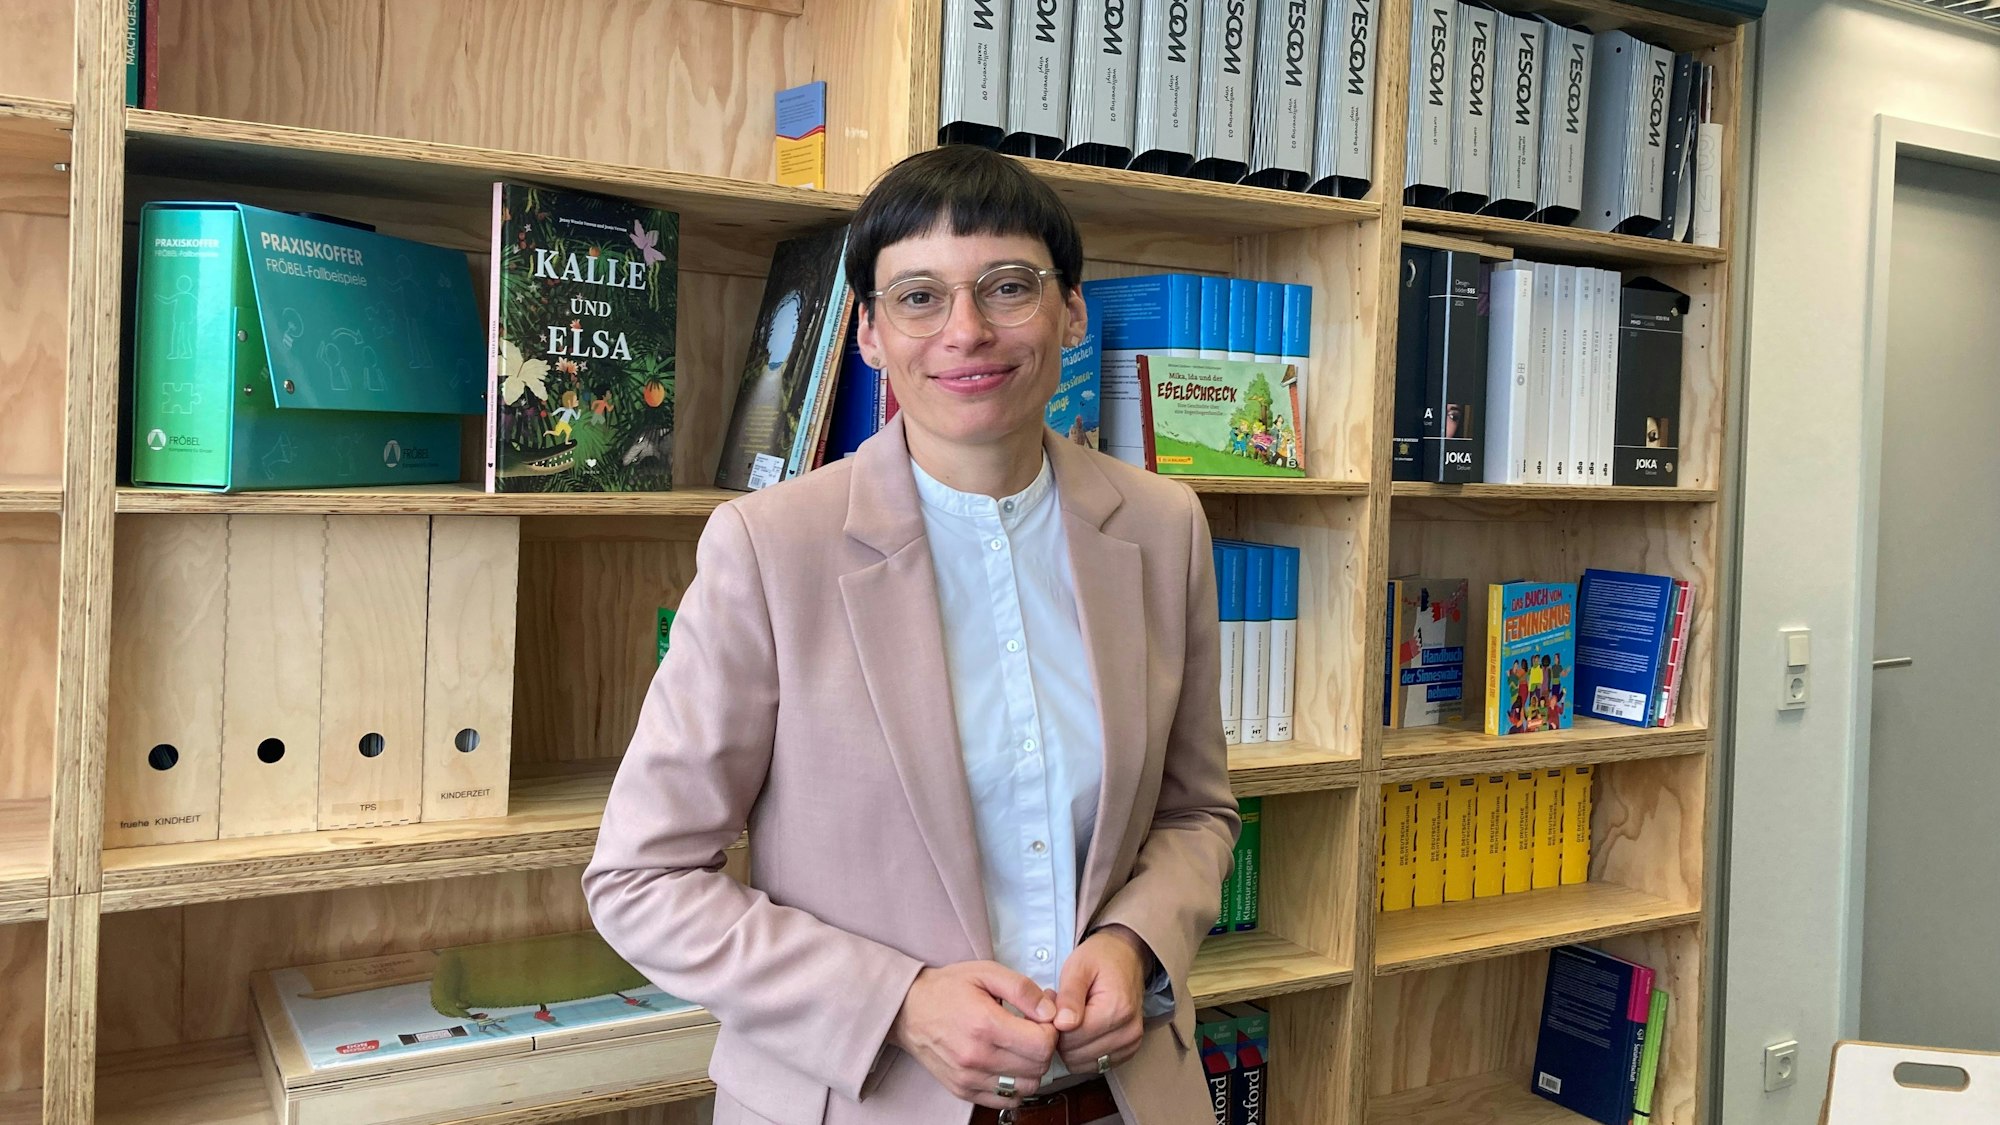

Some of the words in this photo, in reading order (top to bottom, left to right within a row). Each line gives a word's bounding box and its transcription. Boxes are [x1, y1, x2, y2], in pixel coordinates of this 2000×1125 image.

[1285, 0, 1307, 87] ESCOM
[1347, 0, 1370, 95] VESCOM
[981, 44, 989, 89] wallcovering
[1428, 8, 1448, 106] VESCOM
[1469, 21, 1488, 116] VESCOM
[1042, 57, 1050, 101] wallcovering
[1109, 68, 1118, 112] wallcovering
[1515, 32, 1535, 126] VESCOM
[1566, 42, 1585, 135] VESCOM
[1172, 75, 1180, 118] wallcovering
[1648, 60, 1667, 148] VESCOM
[155, 238, 219, 248] PRAXISKOFFER
[260, 231, 364, 267] PRAXISKOFFER
[265, 257, 368, 287] FRÖBEL-Fallbeispiele
[534, 247, 647, 291] KALLE
[570, 298, 612, 318] UND
[832, 310, 842, 334] GROSSE
[546, 325, 633, 361] ELSA
[829, 337, 837, 348] DAS
[1062, 345, 1094, 368] mädchen
[1169, 372, 1187, 381] Mika,
[1199, 374, 1212, 382] und
[1157, 381, 1238, 403] ESELSCHRECK
[169, 434, 200, 446] FRÖBEL
[402, 447, 430, 459] FRÖBEL
[1445, 451, 1471, 464] JOKA
[1635, 458, 1657, 470] JOKA
[1512, 597, 1524, 612] DAS
[1524, 588, 1548, 608] BUCH
[1549, 589, 1563, 602] VOM
[1503, 603, 1571, 644] FEMINISMUS
[1422, 648, 1463, 664] Handbuch
[1402, 670, 1415, 684] der
[1416, 667, 1462, 682] Sinneswahr-
[1428, 685, 1462, 700] nehmung
[1225, 729, 1235, 737] HT
[1252, 728, 1262, 736] HT
[440, 788, 490, 801] KINDERZEIT
[360, 803, 377, 812] TPS
[120, 818, 149, 830] fruehe
[155, 814, 200, 826] KINDHEIT
[1243, 848, 1253, 921] Klausurausgabe
